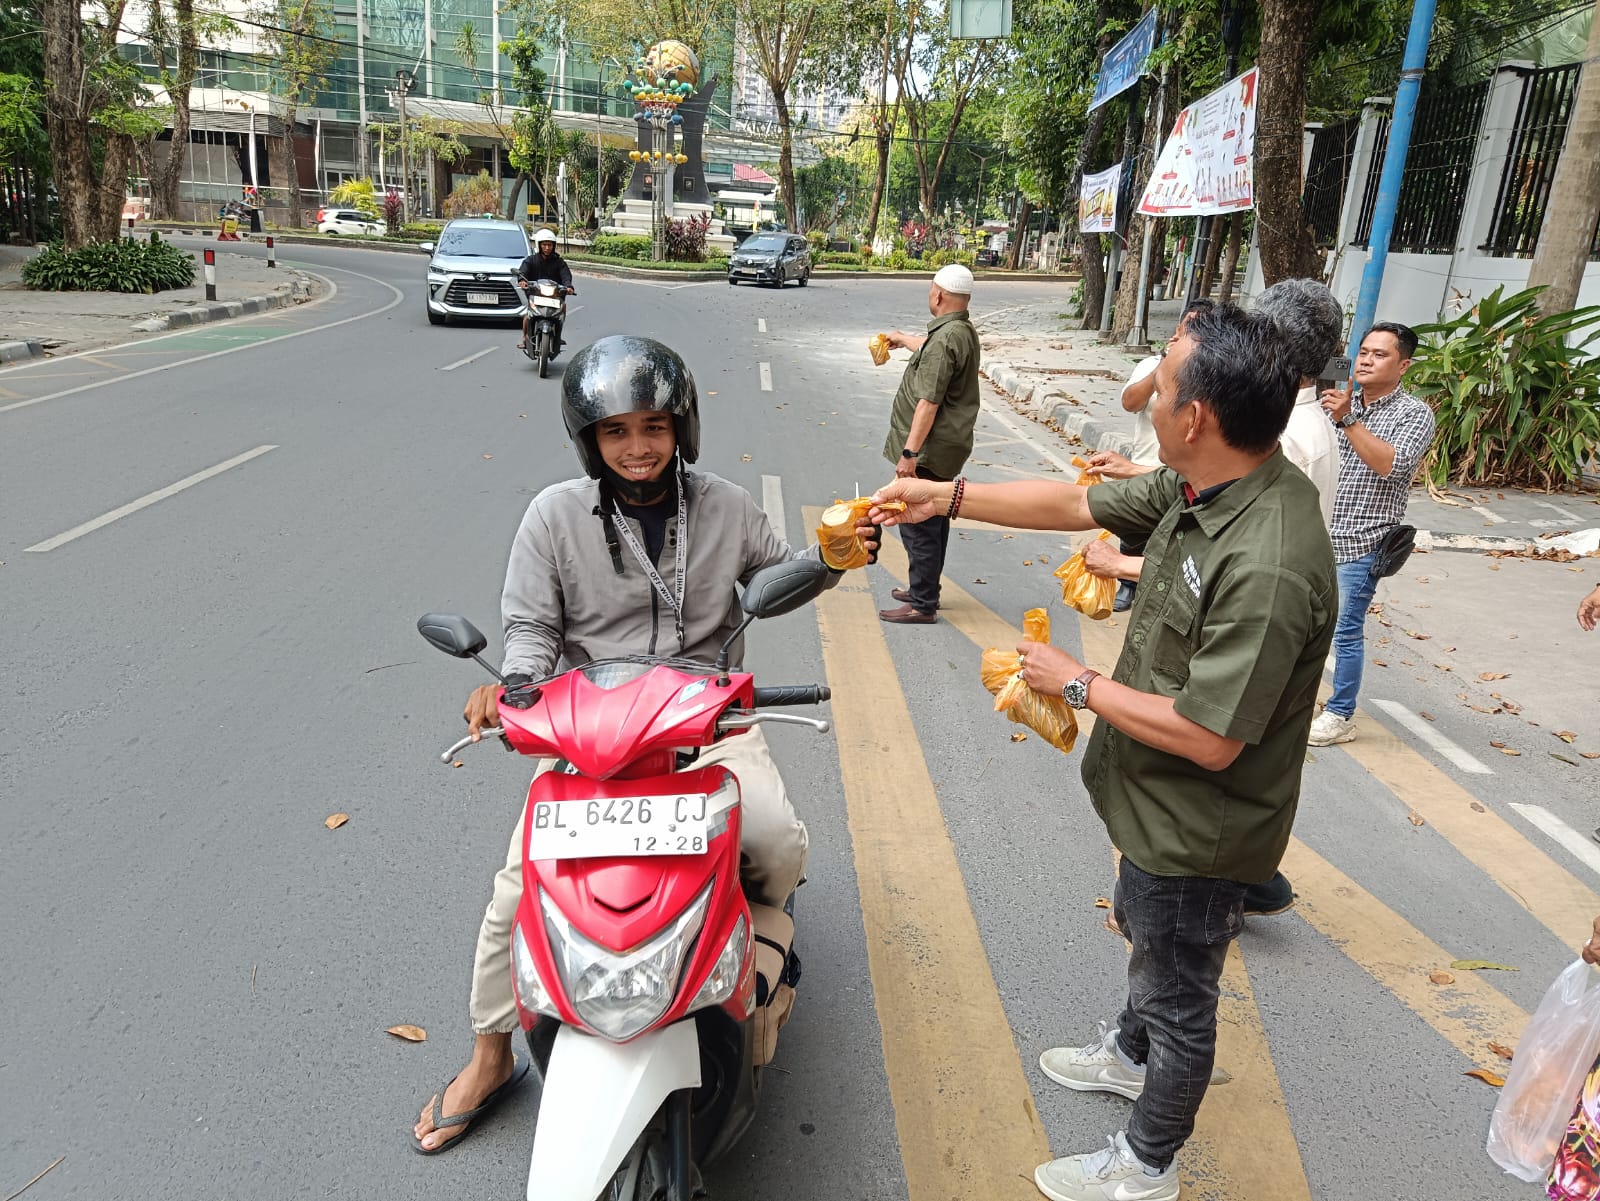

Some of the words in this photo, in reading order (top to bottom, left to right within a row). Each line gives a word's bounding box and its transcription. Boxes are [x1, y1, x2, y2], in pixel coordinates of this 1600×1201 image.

[535, 803, 567, 829] BL
[586, 798, 652, 826] 6426
[674, 796, 706, 823] CJ
